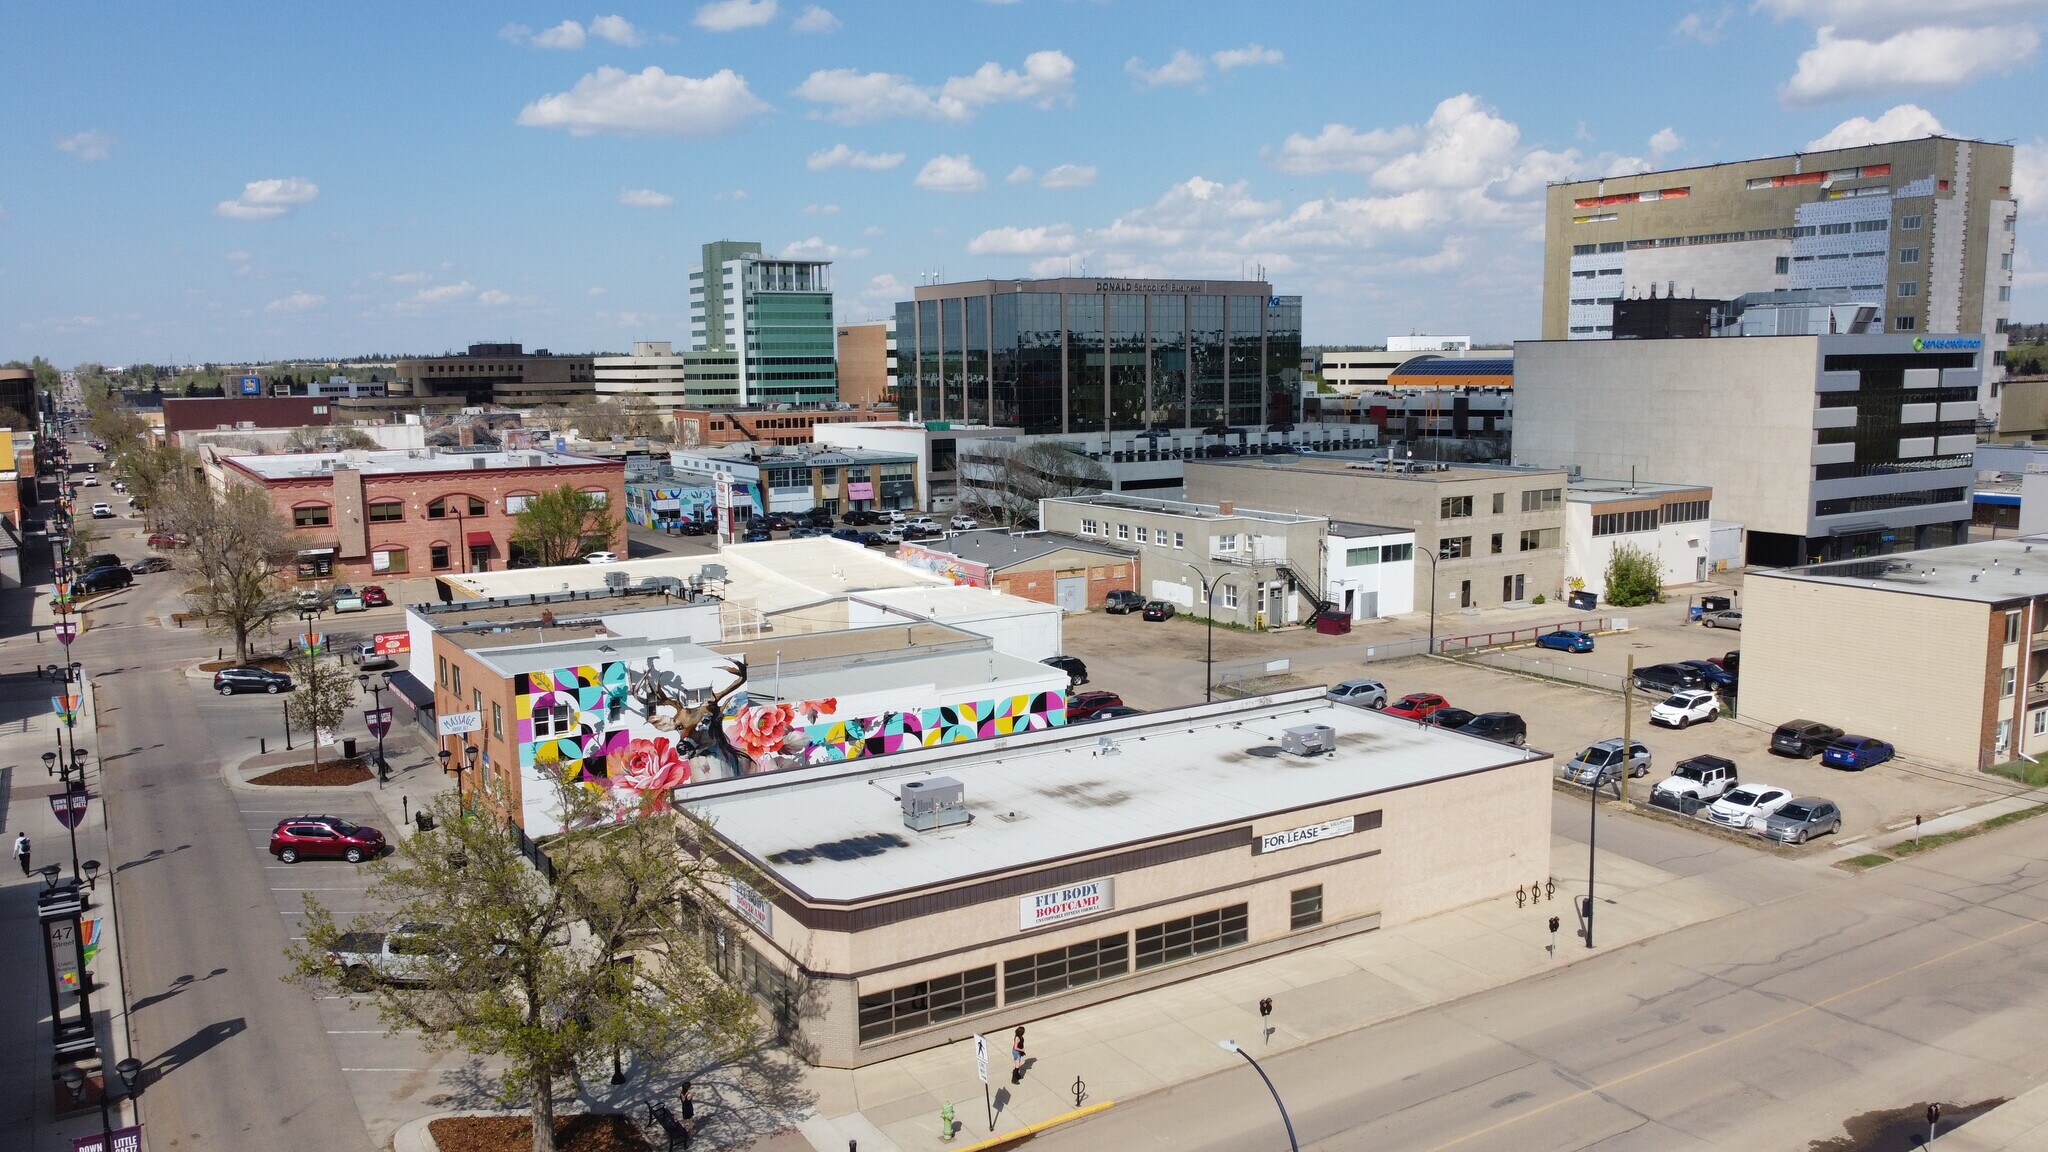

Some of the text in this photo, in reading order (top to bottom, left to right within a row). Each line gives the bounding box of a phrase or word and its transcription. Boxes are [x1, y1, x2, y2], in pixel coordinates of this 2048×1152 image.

[1096, 282, 1201, 292] DONALD School of Business
[443, 714, 476, 730] MASSAGE
[73, 795, 86, 803] LITTLE
[1264, 835, 1285, 848] FOR
[1287, 827, 1319, 843] LEASE
[1035, 883, 1099, 907] FIT BODY
[1036, 895, 1099, 918] BOOTCAMP
[1036, 905, 1099, 923] UNSTOPPABLE FITNESS FORMULA
[52, 926, 73, 941] 47
[52, 940, 75, 949] Street
[79, 1143, 103, 1152] DOWN
[114, 1135, 138, 1148] LITTLE
